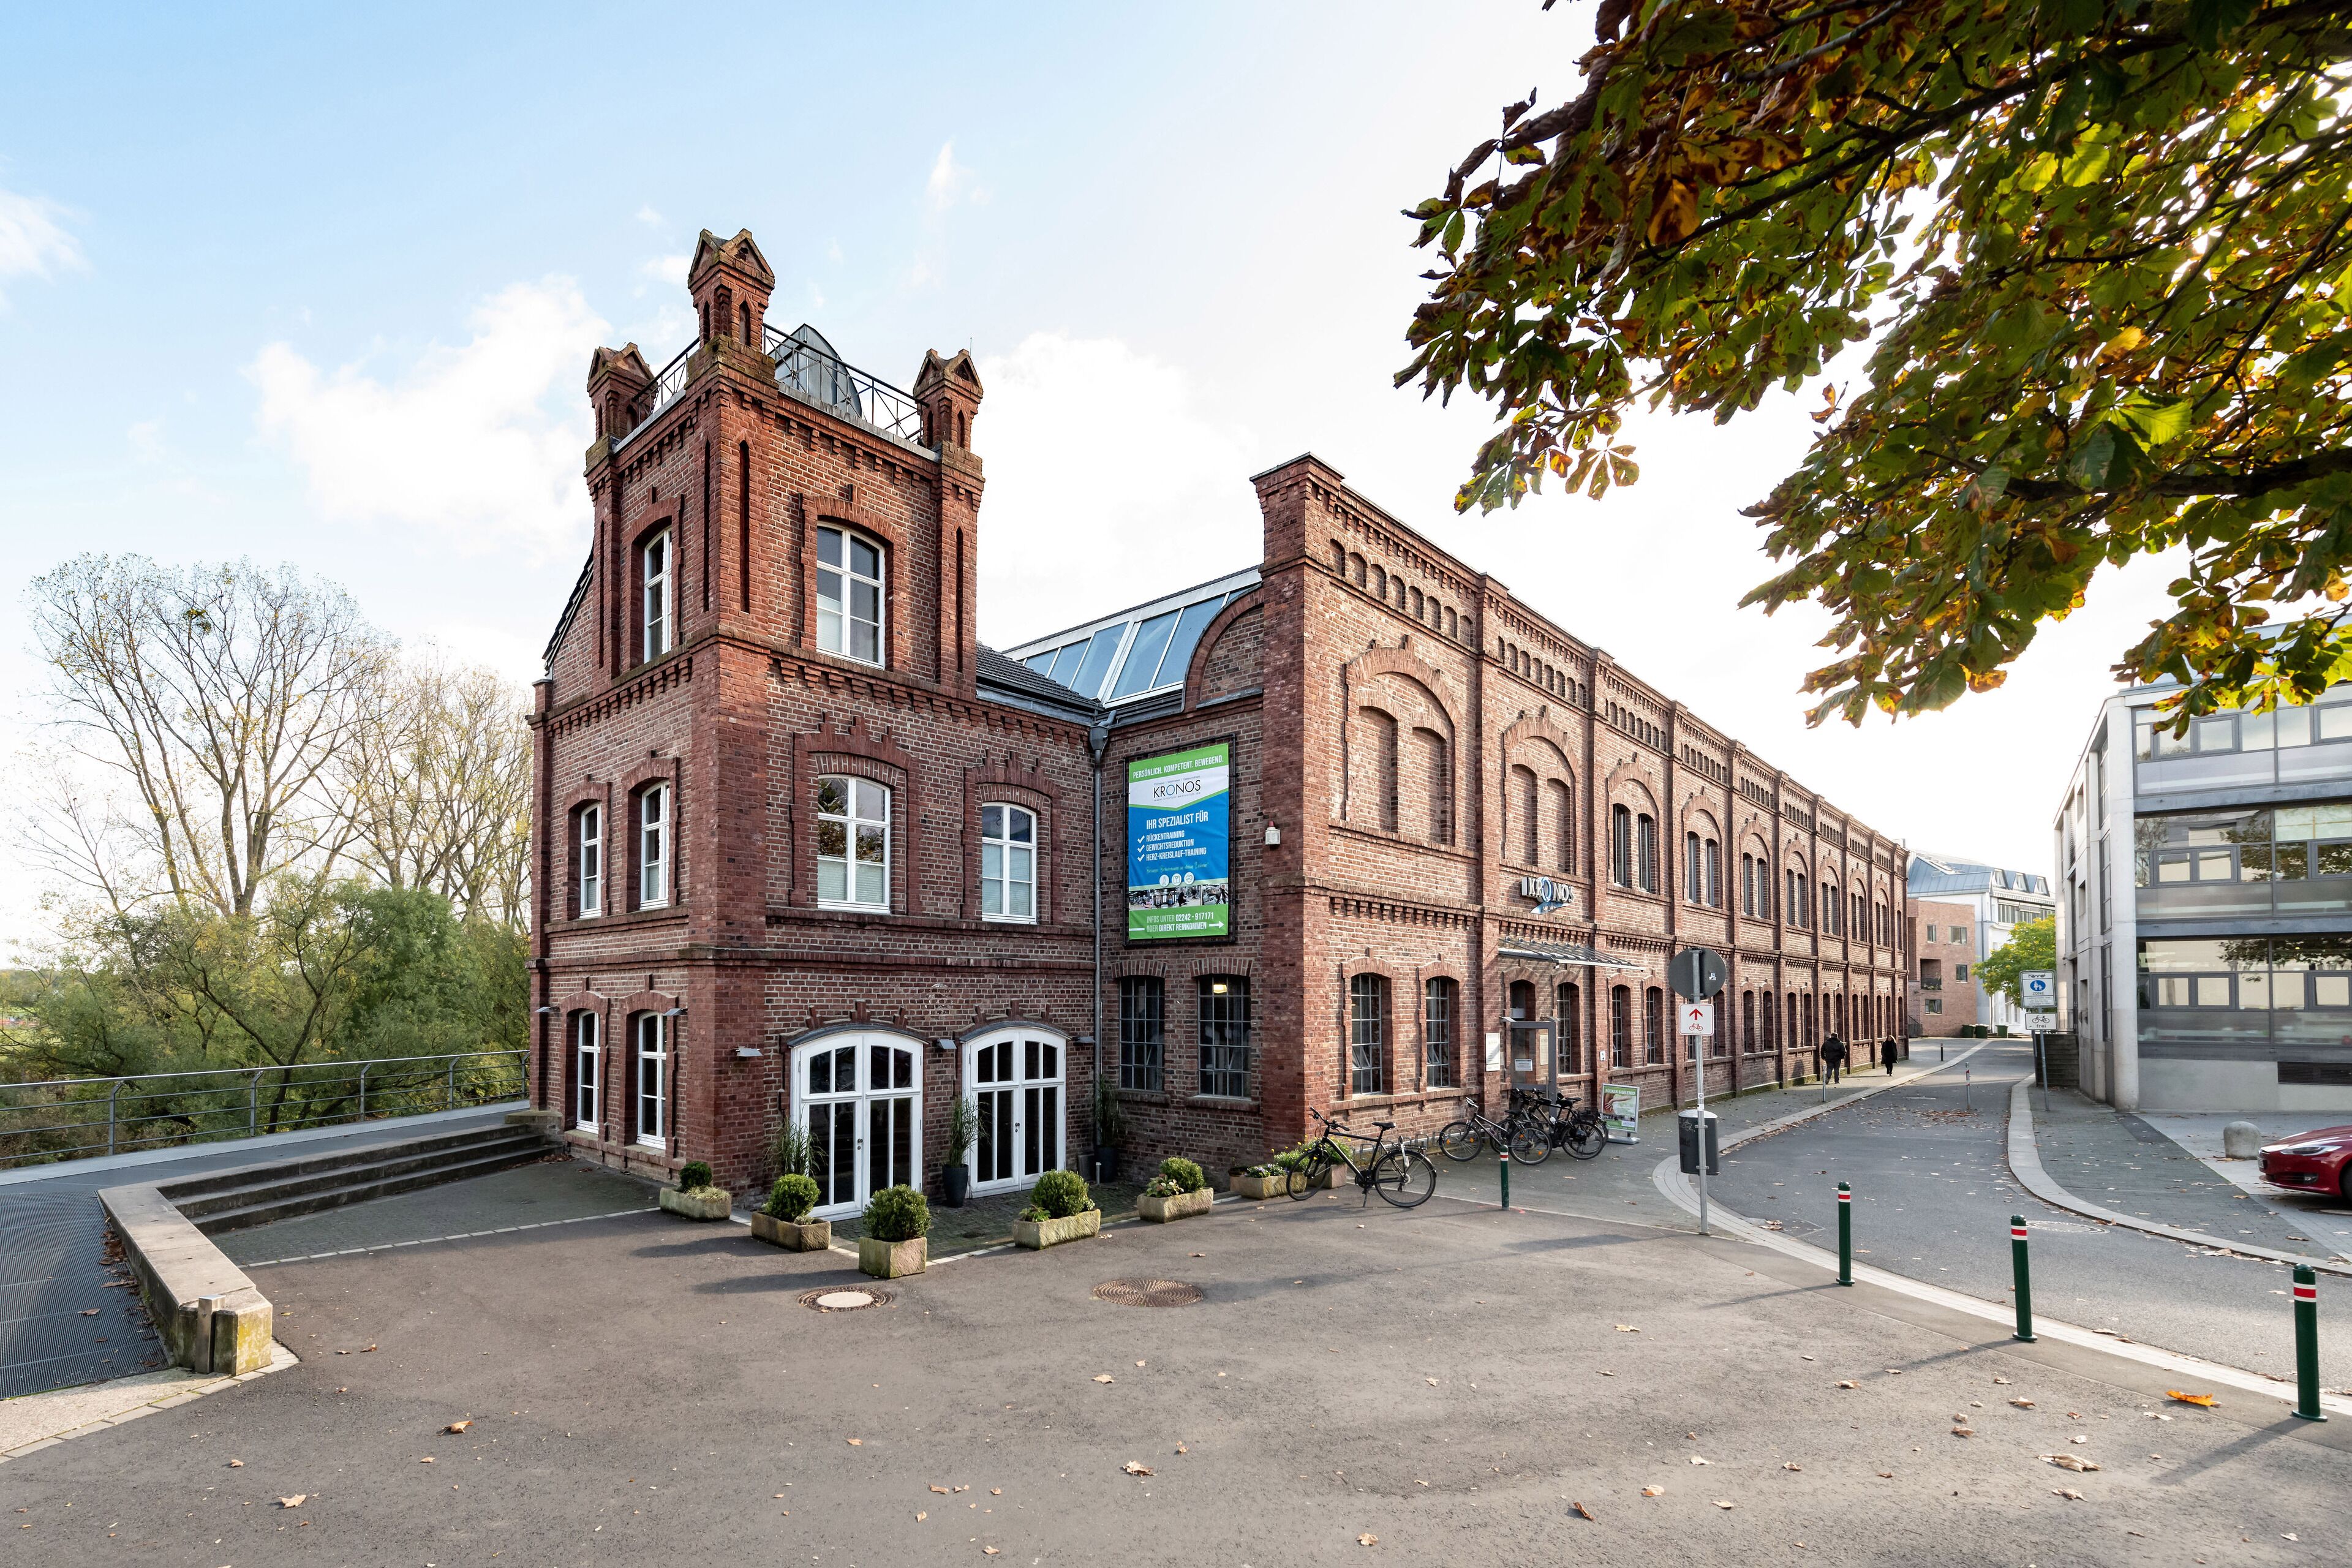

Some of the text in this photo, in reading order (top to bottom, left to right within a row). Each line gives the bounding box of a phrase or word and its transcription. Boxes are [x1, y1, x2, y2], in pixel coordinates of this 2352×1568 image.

[1133, 755, 1224, 778] PERSÖNLICH. KOMPETENT. BEWEGEND.
[1154, 780, 1200, 798] KRONOS
[1146, 810, 1208, 829] IHR SPEZIALIST FÜR
[1146, 831, 1185, 842] RÜCKENTRAINING
[1146, 839, 1194, 851] GEWICHTSREDUKTION
[1146, 847, 1207, 861] HERZ-KREISLAUF-TRAINING
[1527, 876, 1574, 903] KRONOS
[1175, 922, 1207, 930] REINKOMMEN
